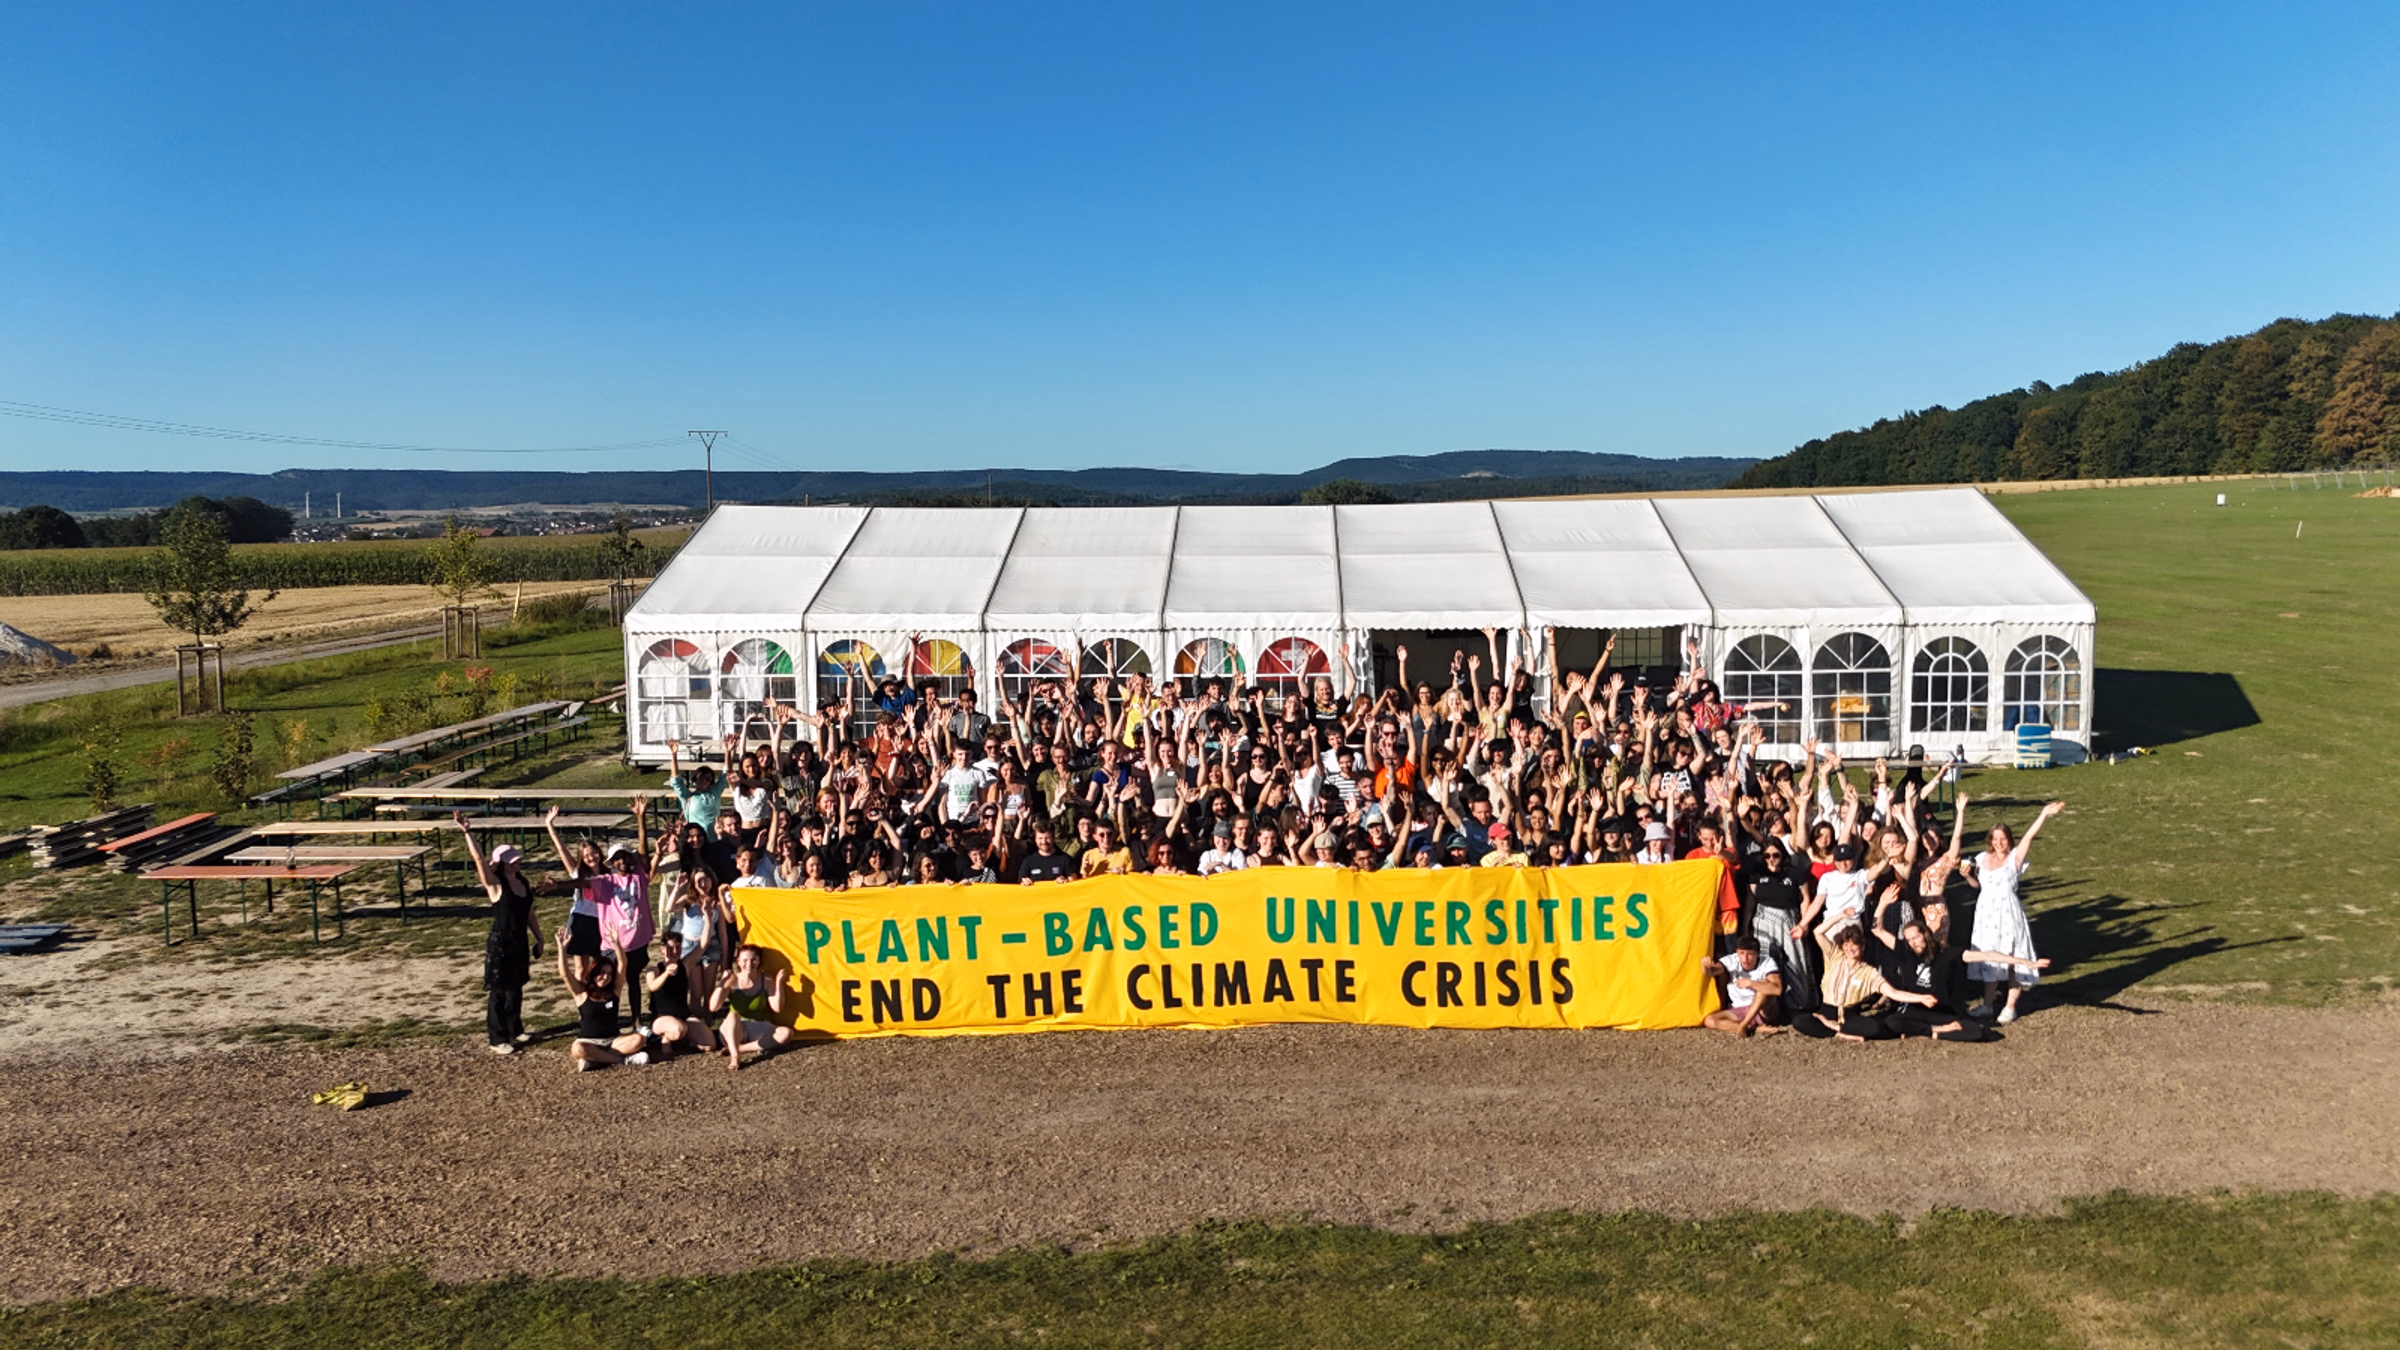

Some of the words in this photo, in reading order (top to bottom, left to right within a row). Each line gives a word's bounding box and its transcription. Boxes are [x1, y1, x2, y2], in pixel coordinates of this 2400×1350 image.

[1267, 893, 1649, 946] UNIVERSITIES
[841, 978, 942, 1024] END
[987, 969, 1084, 1018] THE
[1127, 958, 1357, 1010] CLIMATE
[1401, 958, 1574, 1008] CRISIS
